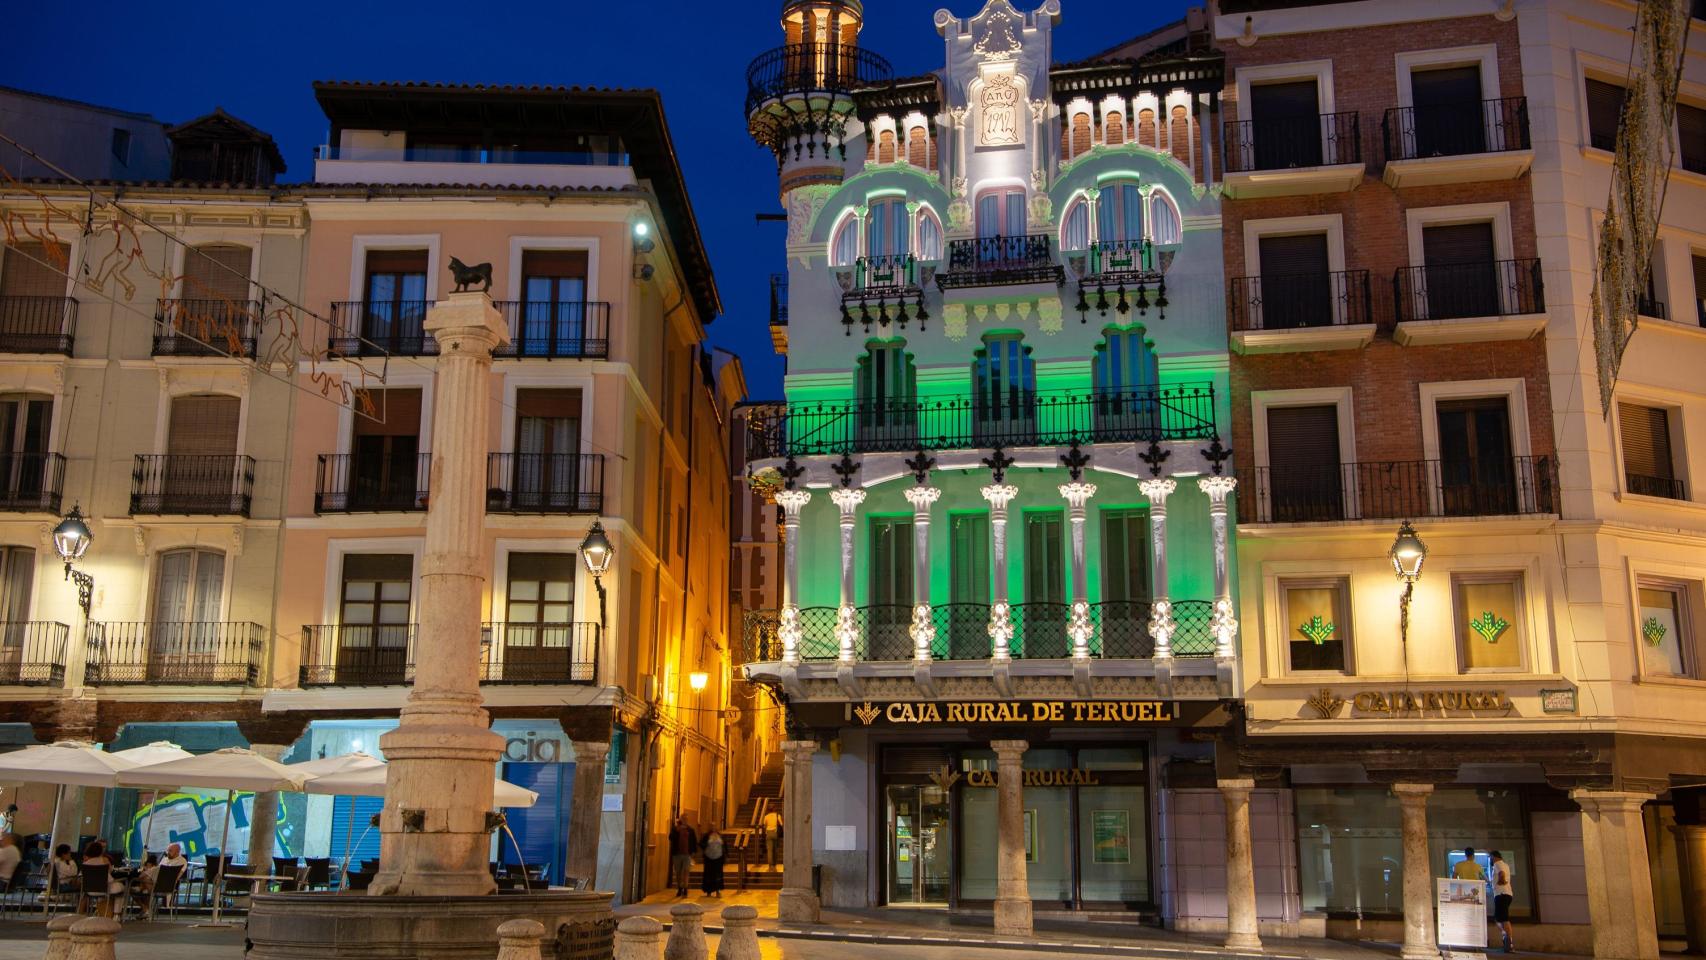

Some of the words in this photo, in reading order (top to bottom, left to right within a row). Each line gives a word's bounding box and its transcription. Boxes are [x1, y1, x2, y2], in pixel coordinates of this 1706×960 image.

[987, 110, 1013, 133] 1912
[1354, 690, 1421, 712] CAJA
[1421, 690, 1511, 711] RURAL
[886, 702, 942, 723] CAJA
[947, 702, 1028, 722] RURAL
[1032, 702, 1064, 721] DE
[1071, 702, 1171, 721] TERUEL
[505, 731, 560, 762] cia
[967, 768, 1000, 788] CA
[1024, 767, 1099, 786] RURAL
